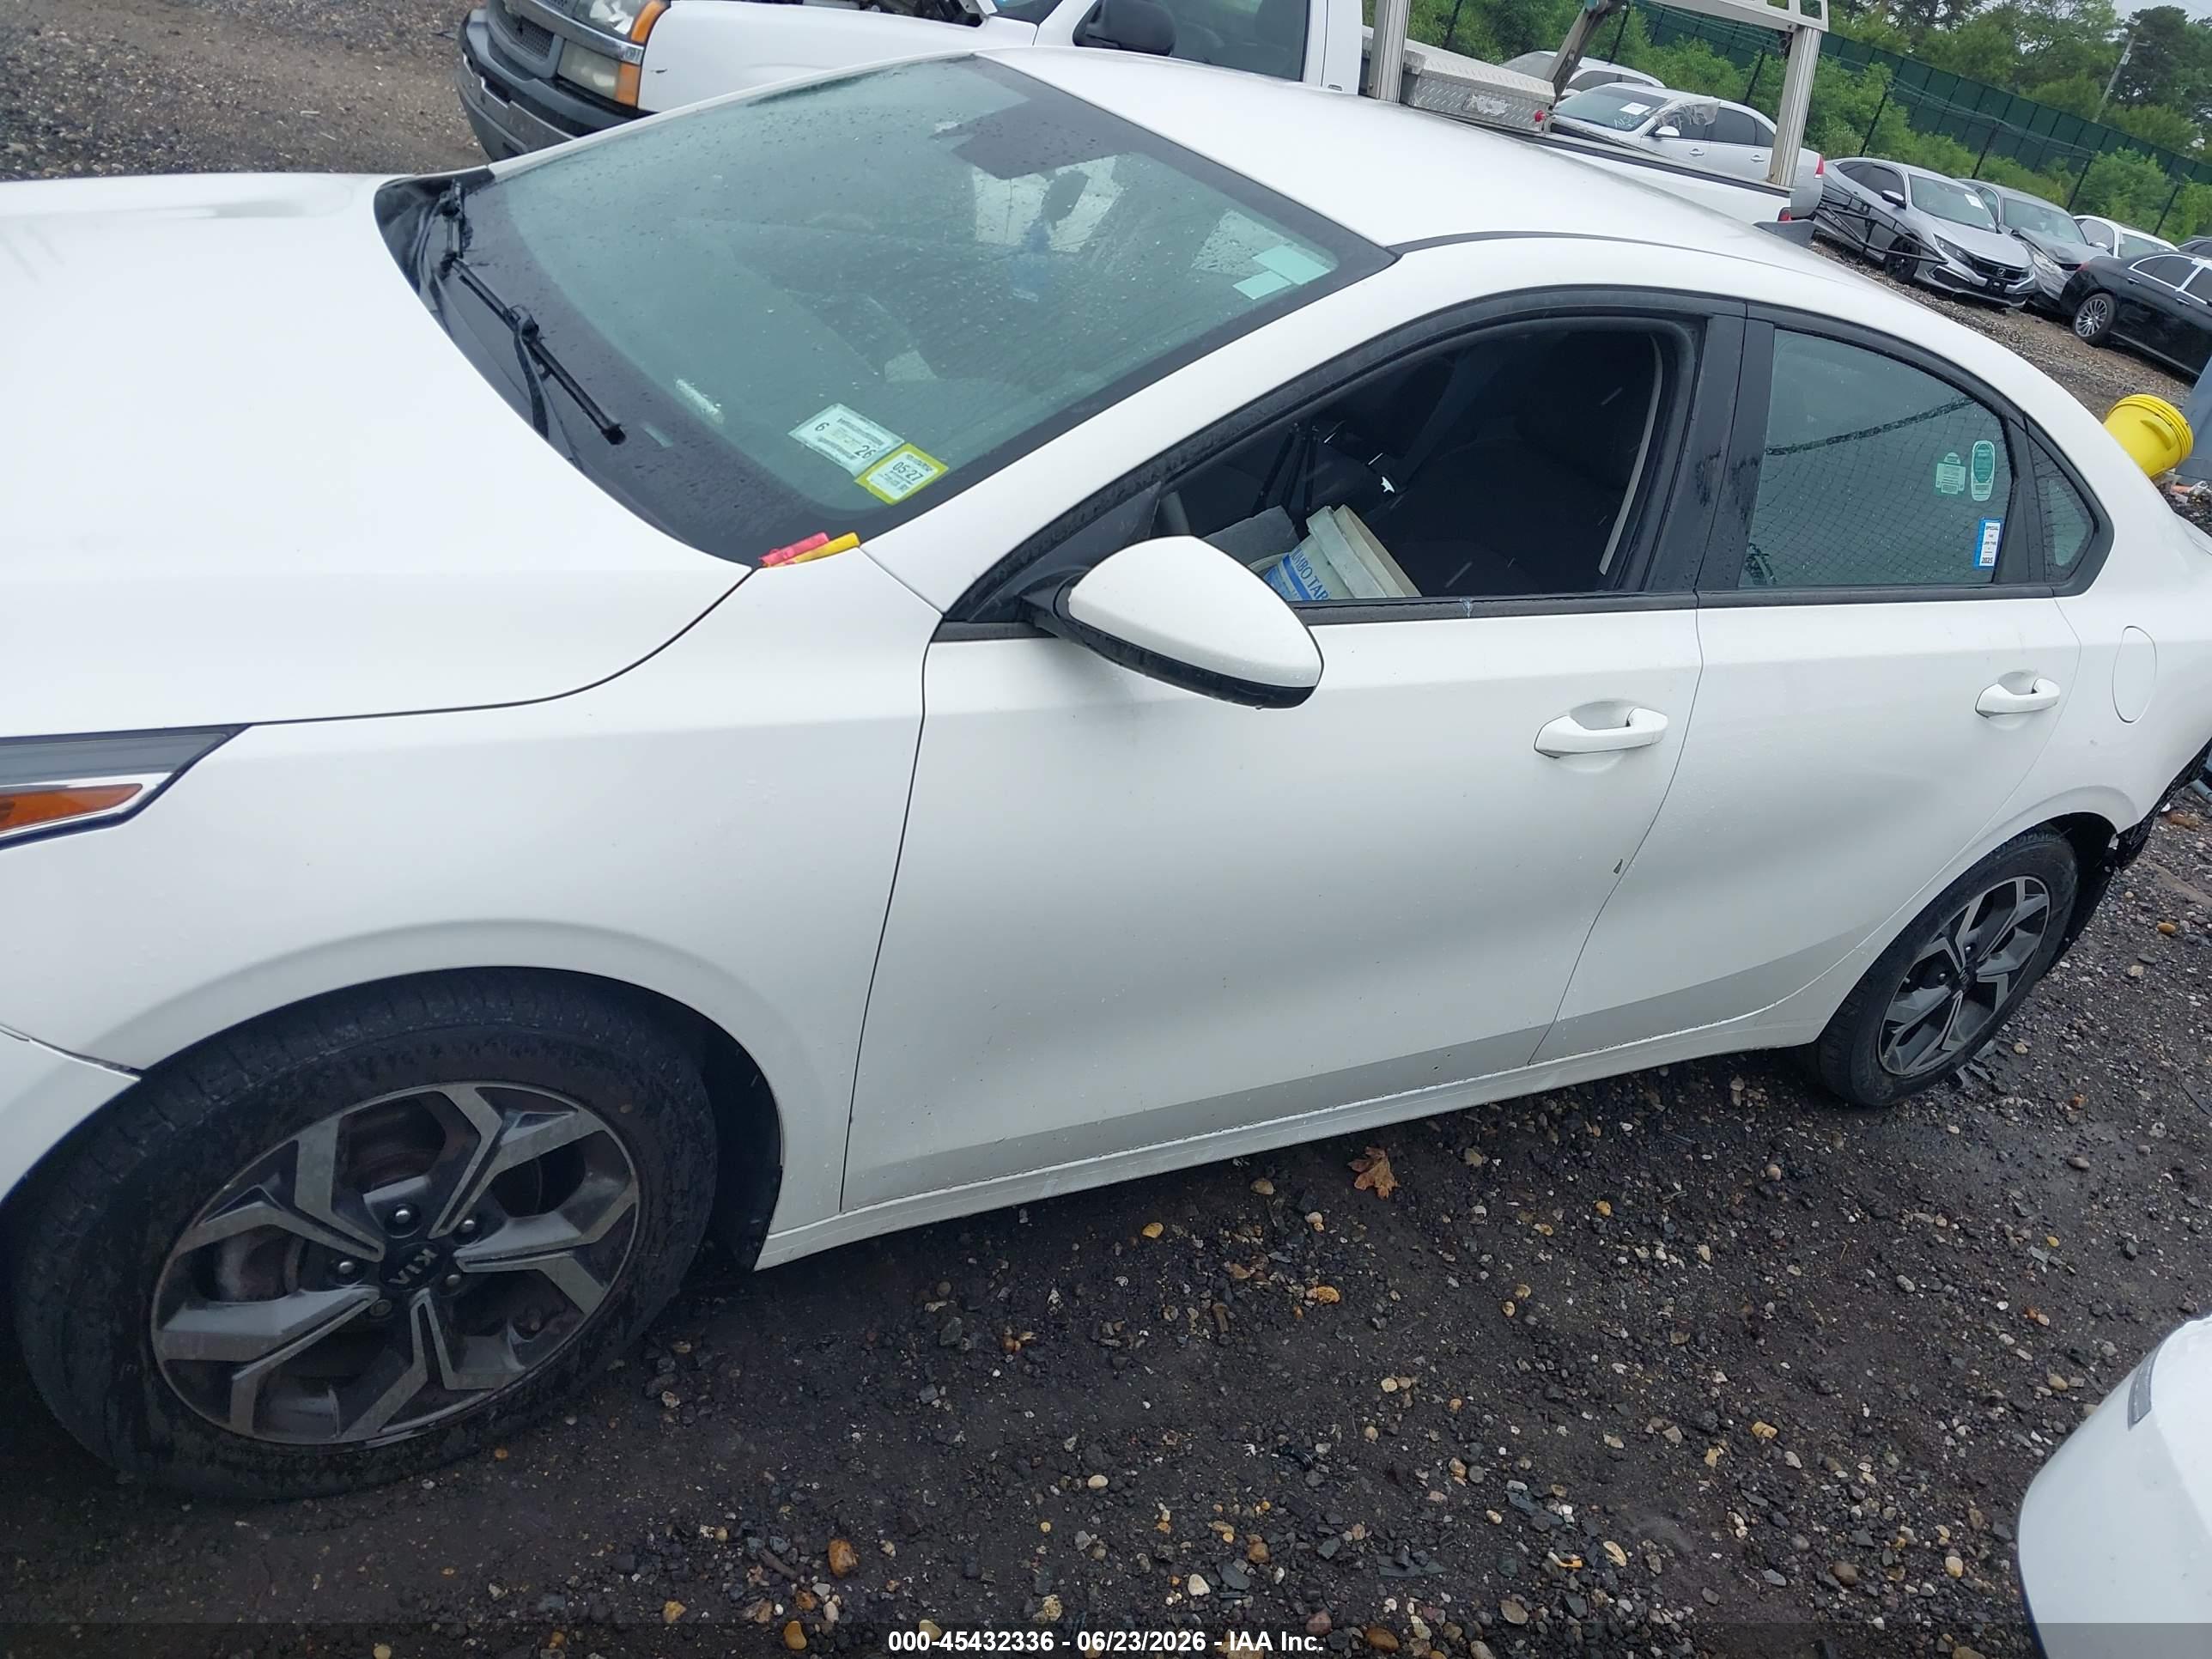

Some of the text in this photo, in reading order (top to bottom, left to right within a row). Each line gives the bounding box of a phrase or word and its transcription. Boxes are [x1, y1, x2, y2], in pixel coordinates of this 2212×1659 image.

[814, 422, 830, 431] 6
[854, 445, 877, 459] 26
[1291, 547, 1313, 580] UMBO
[387, 1248, 439, 1285] KIA
